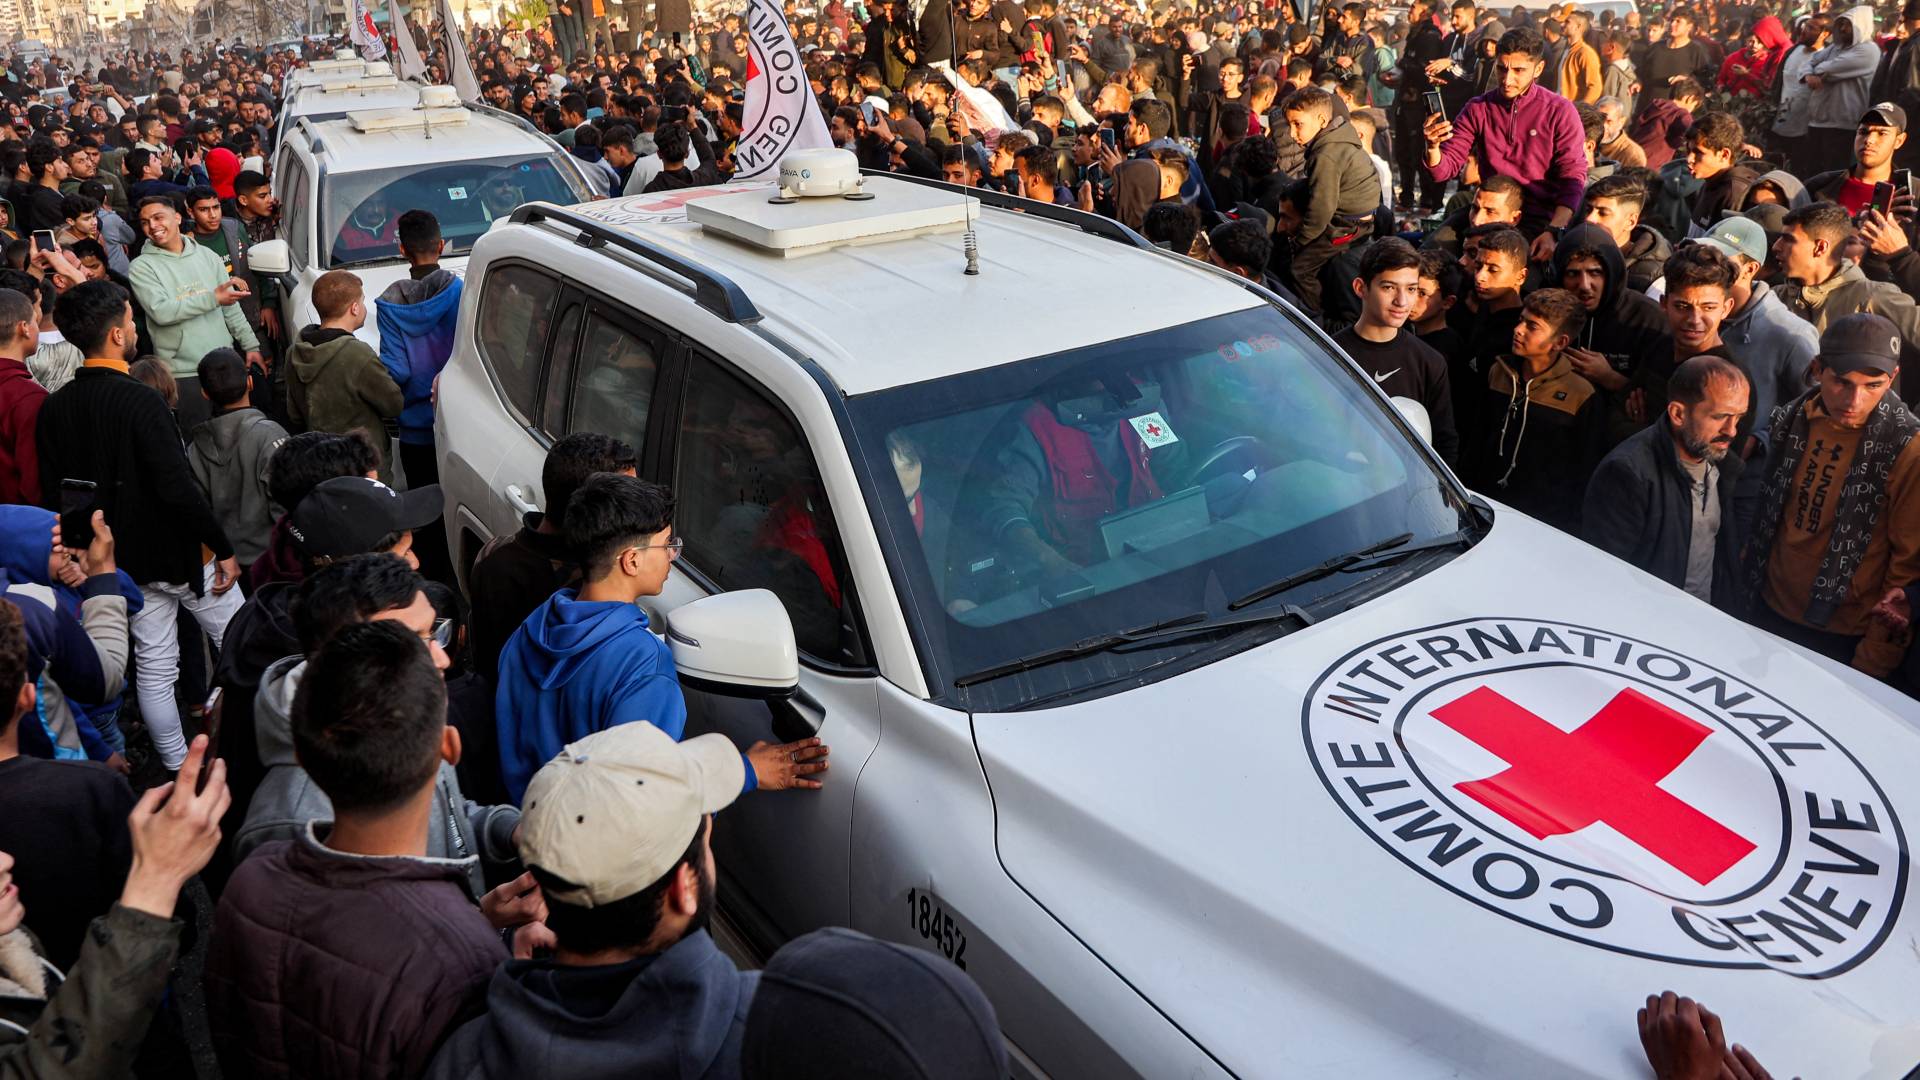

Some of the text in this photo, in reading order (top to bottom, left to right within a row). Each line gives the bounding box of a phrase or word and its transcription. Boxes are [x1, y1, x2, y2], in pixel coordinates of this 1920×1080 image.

[1794, 460, 1818, 529] ARMOUR
[1807, 464, 1836, 534] UNDER
[1323, 623, 1826, 929] COMITE INTERNATIONAL
[1671, 790, 1882, 963] GENEVE
[907, 887, 967, 972] 18452
